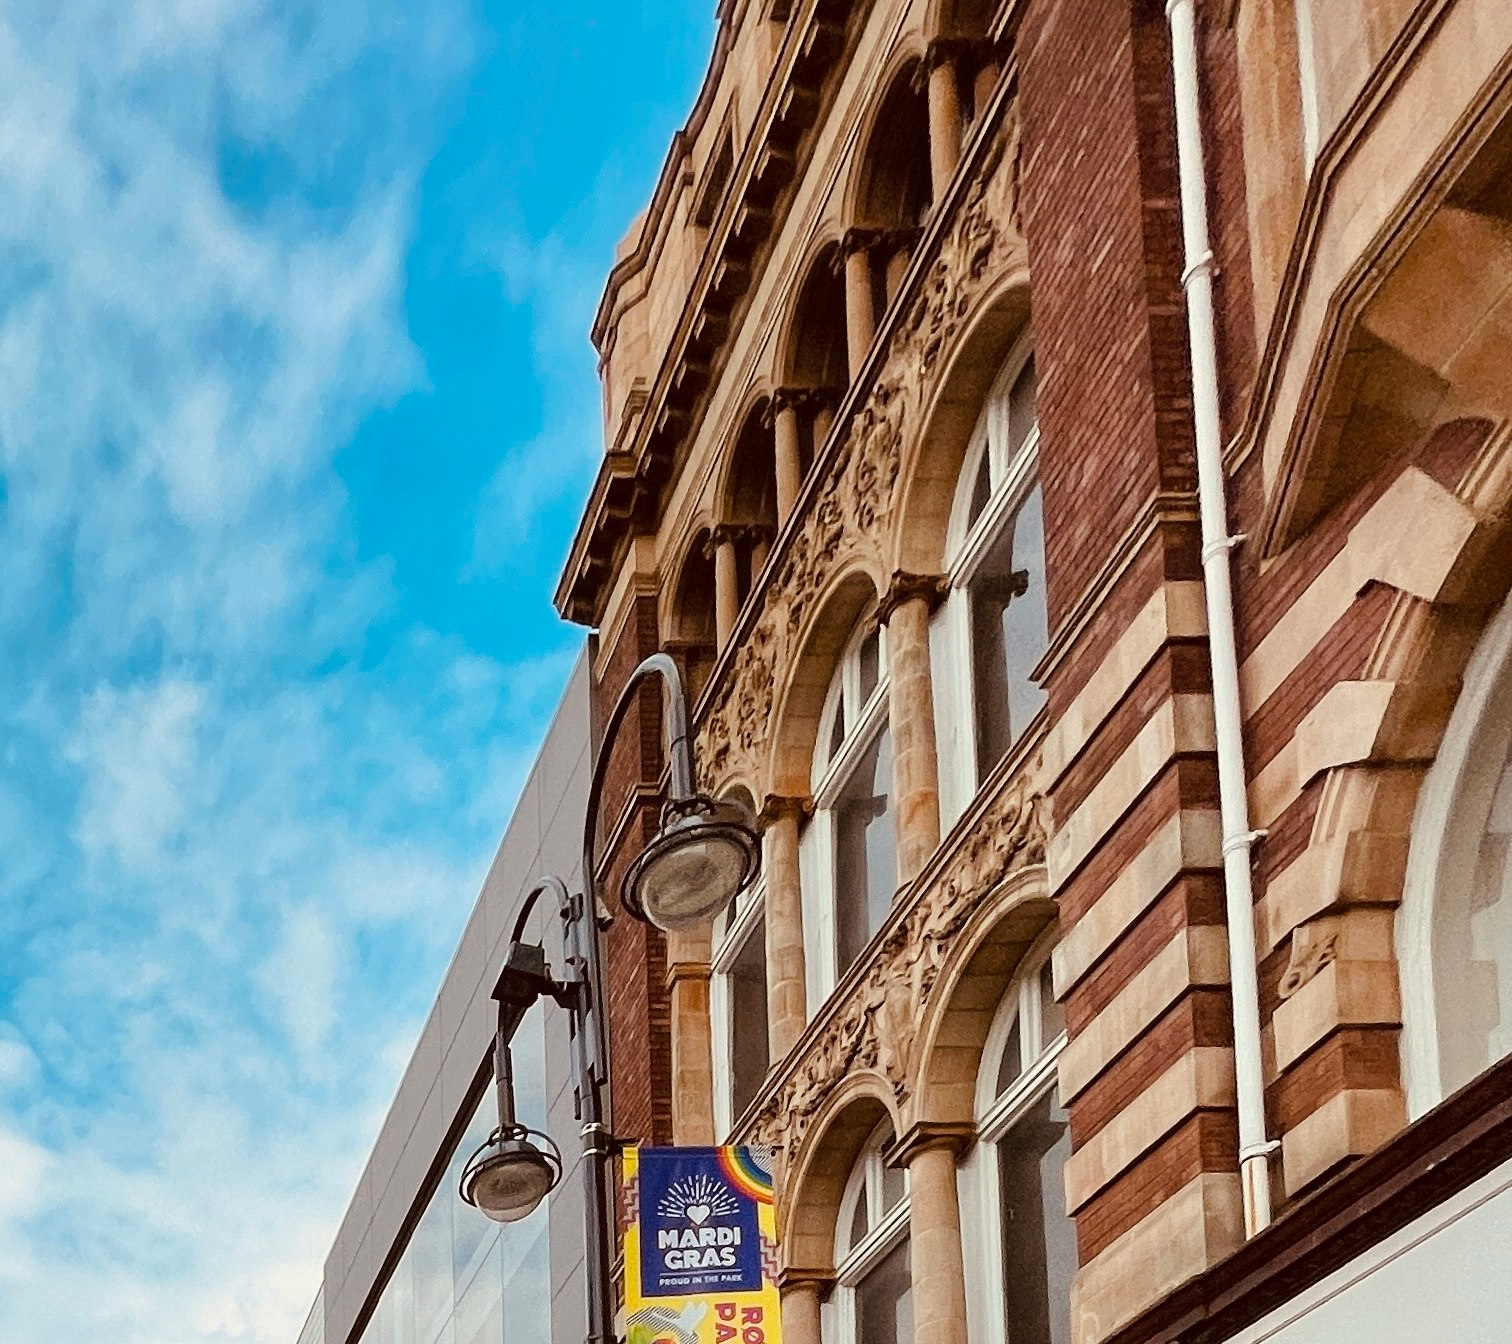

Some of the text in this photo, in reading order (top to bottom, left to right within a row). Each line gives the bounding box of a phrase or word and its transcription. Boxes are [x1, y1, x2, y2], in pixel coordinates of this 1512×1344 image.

[657, 1227, 742, 1249] MARDI
[664, 1247, 737, 1270] GRAS
[658, 1277, 690, 1287] PROUD
[692, 1276, 702, 1285] IN
[720, 1273, 743, 1282] PARK
